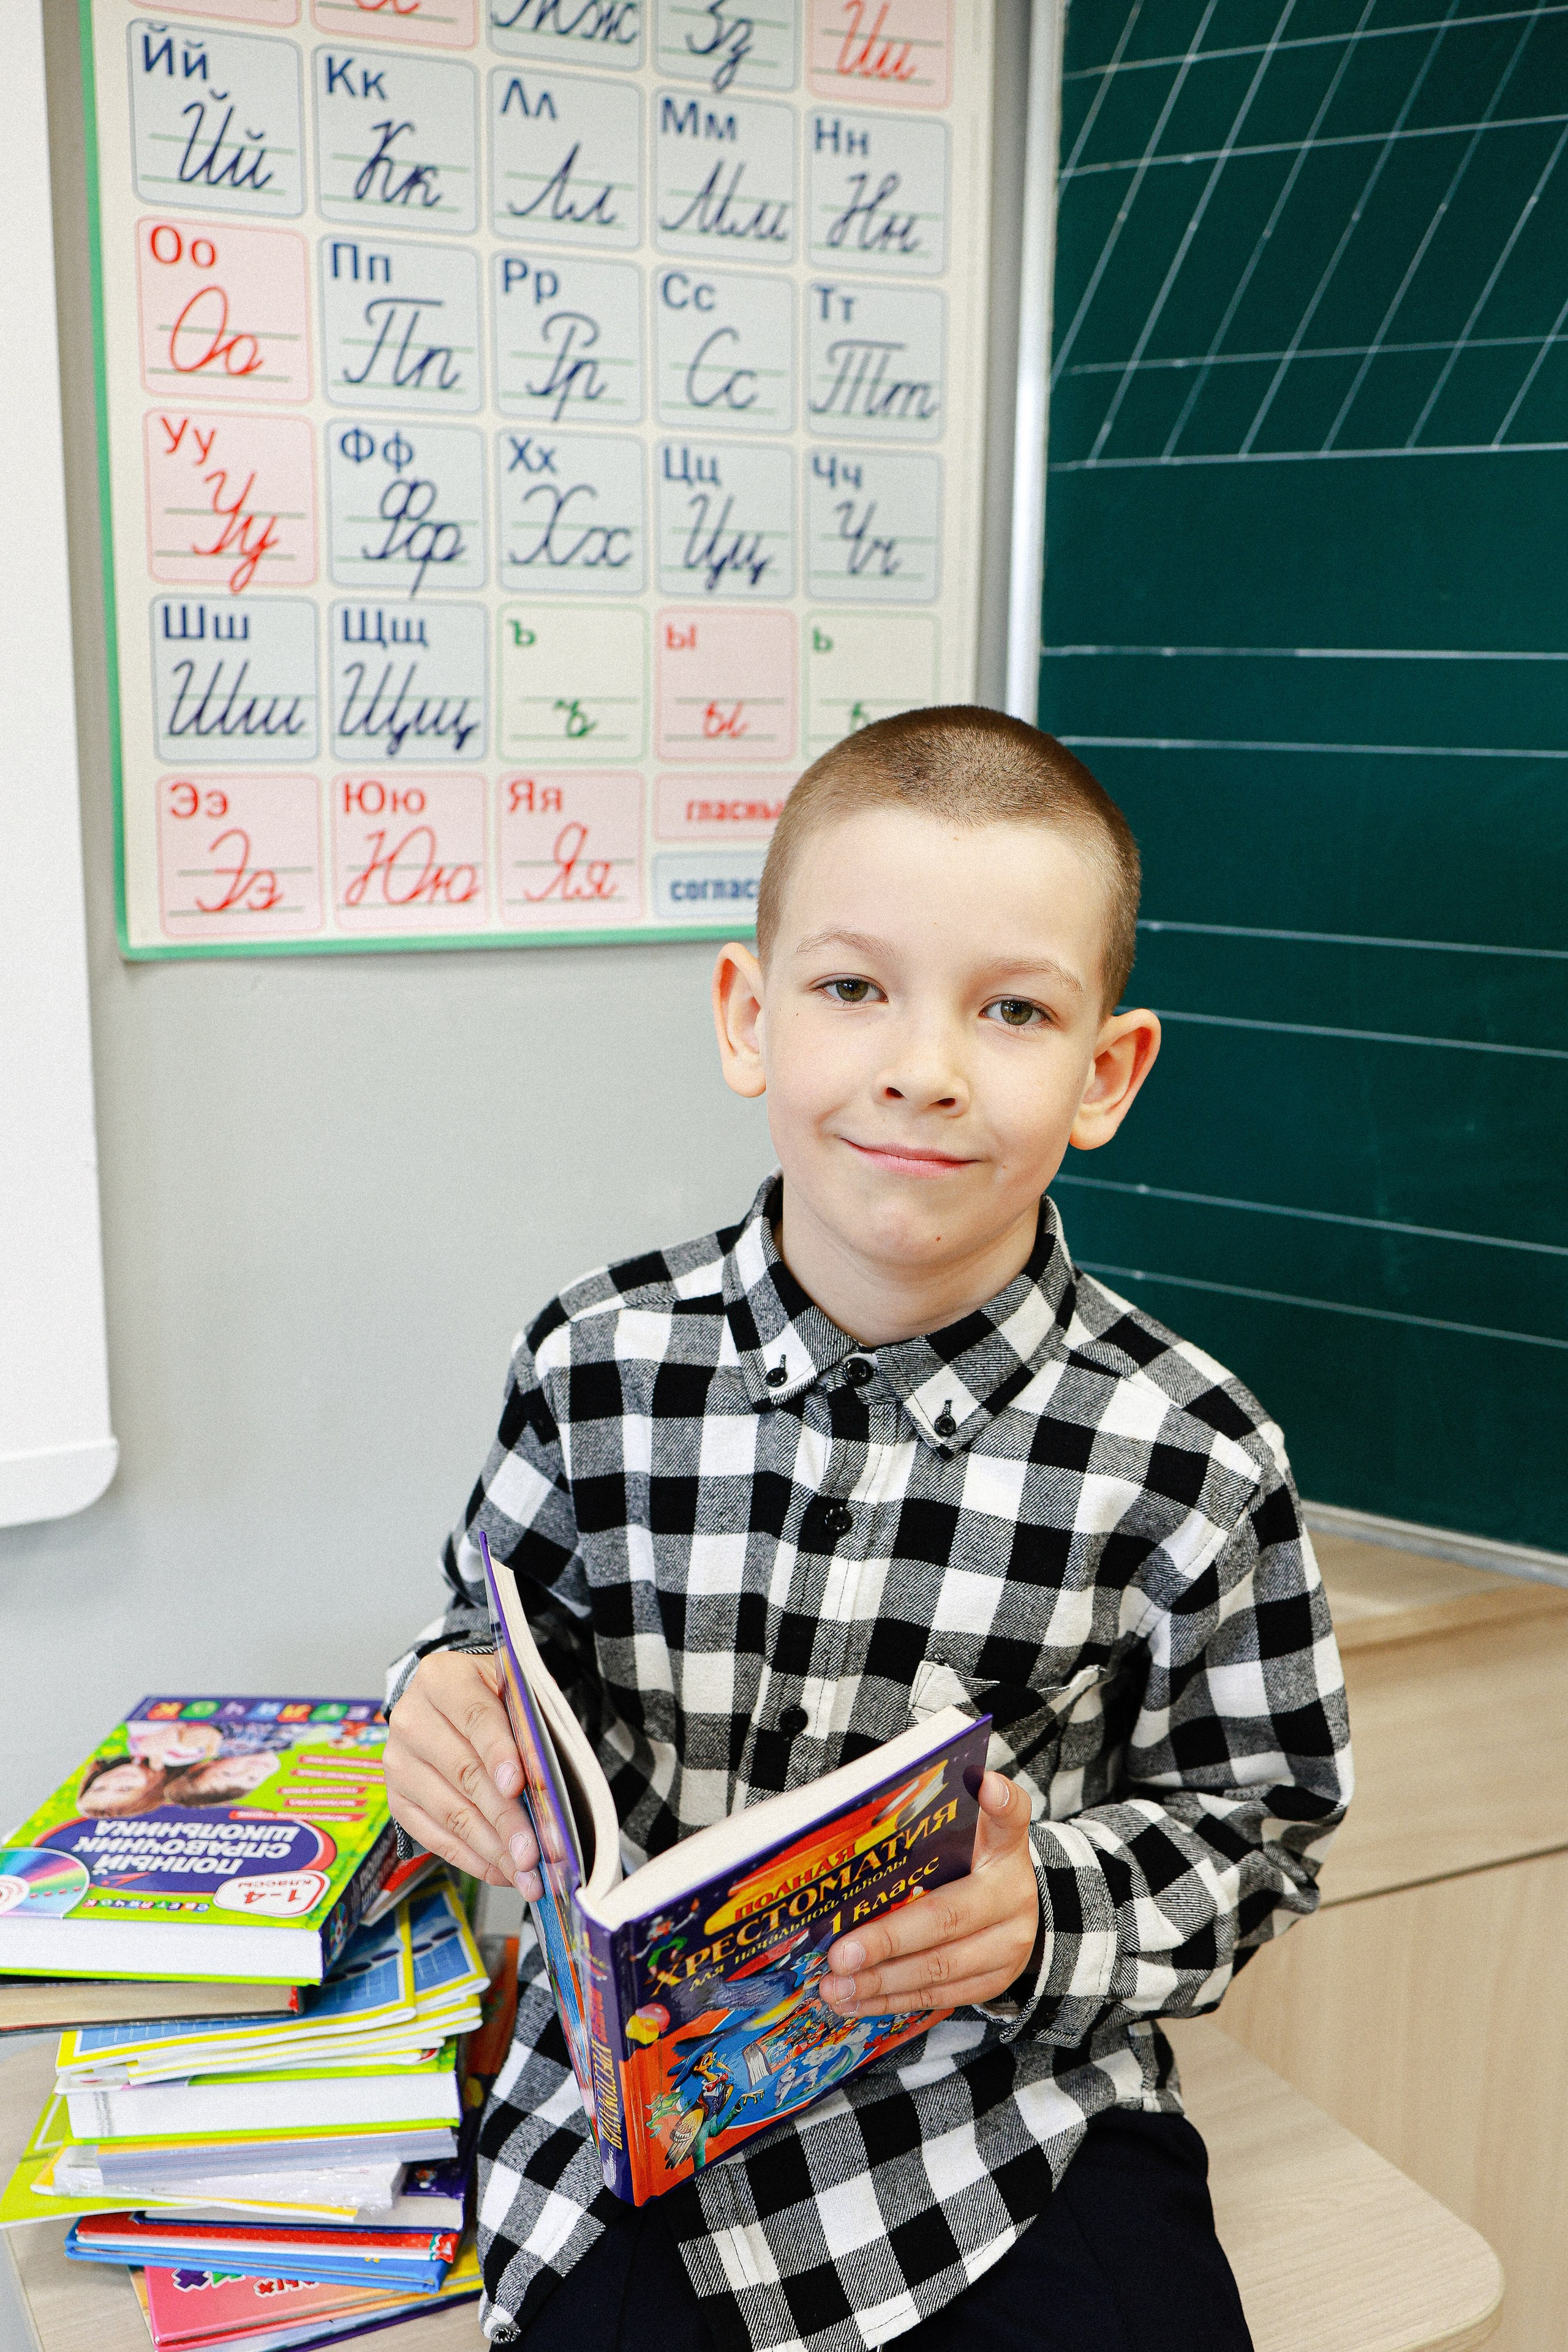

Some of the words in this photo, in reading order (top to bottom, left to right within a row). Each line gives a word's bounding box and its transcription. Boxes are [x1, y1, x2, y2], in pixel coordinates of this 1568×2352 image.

[142, 23, 209, 80] Йй
[327, 56, 389, 101] Кк
[500, 78, 558, 119] Лл
[661, 99, 737, 141] Мм
[814, 118, 870, 156] Нн
[178, 89, 274, 190] Йй
[355, 121, 443, 208] Кк
[505, 141, 619, 225] Лл
[660, 159, 789, 241] Мм
[827, 172, 921, 254] Нн
[150, 225, 216, 268] Оо
[333, 242, 392, 284] Пп
[502, 257, 560, 305] Рр
[169, 285, 263, 376] Оо
[661, 273, 716, 312] Сс
[815, 286, 857, 323] Тт
[342, 297, 459, 390] Пп
[525, 311, 608, 423] Рр
[685, 326, 759, 410] Сс
[810, 339, 940, 419] Тт
[161, 417, 216, 466] Уу
[339, 428, 415, 473] Фф
[507, 436, 558, 474] Хх
[663, 447, 720, 488] Цц
[813, 454, 864, 488] Чч
[192, 470, 279, 595] Уу
[361, 478, 466, 598] Фф
[509, 483, 633, 567] Хх
[684, 492, 773, 591] Цц
[835, 499, 905, 576] Чч
[164, 605, 249, 641] Шш
[342, 607, 429, 649] Щщ
[169, 658, 307, 737] Шш
[339, 661, 479, 755] Щщ
[169, 782, 228, 818] Ээ
[344, 780, 426, 815] Юю
[509, 780, 563, 813] Яя
[195, 829, 284, 913] Ээ
[345, 825, 478, 905] Юю
[524, 823, 618, 902] Яя
[72, 1836, 292, 1859] СПРАВОЧНИК
[91, 1853, 244, 1876] ПОЛНЫЙ
[94, 1820, 301, 1843] ШКОЛЬНИКА
[650, 1798, 959, 1998] ХРЕСТОМАТИЯ
[735, 1842, 856, 1921] ПОЛНАЯ
[735, 1898, 839, 1964] начальной
[842, 1855, 907, 1901] школы
[830, 1911, 843, 1936] 1
[853, 1856, 940, 1923] класс
